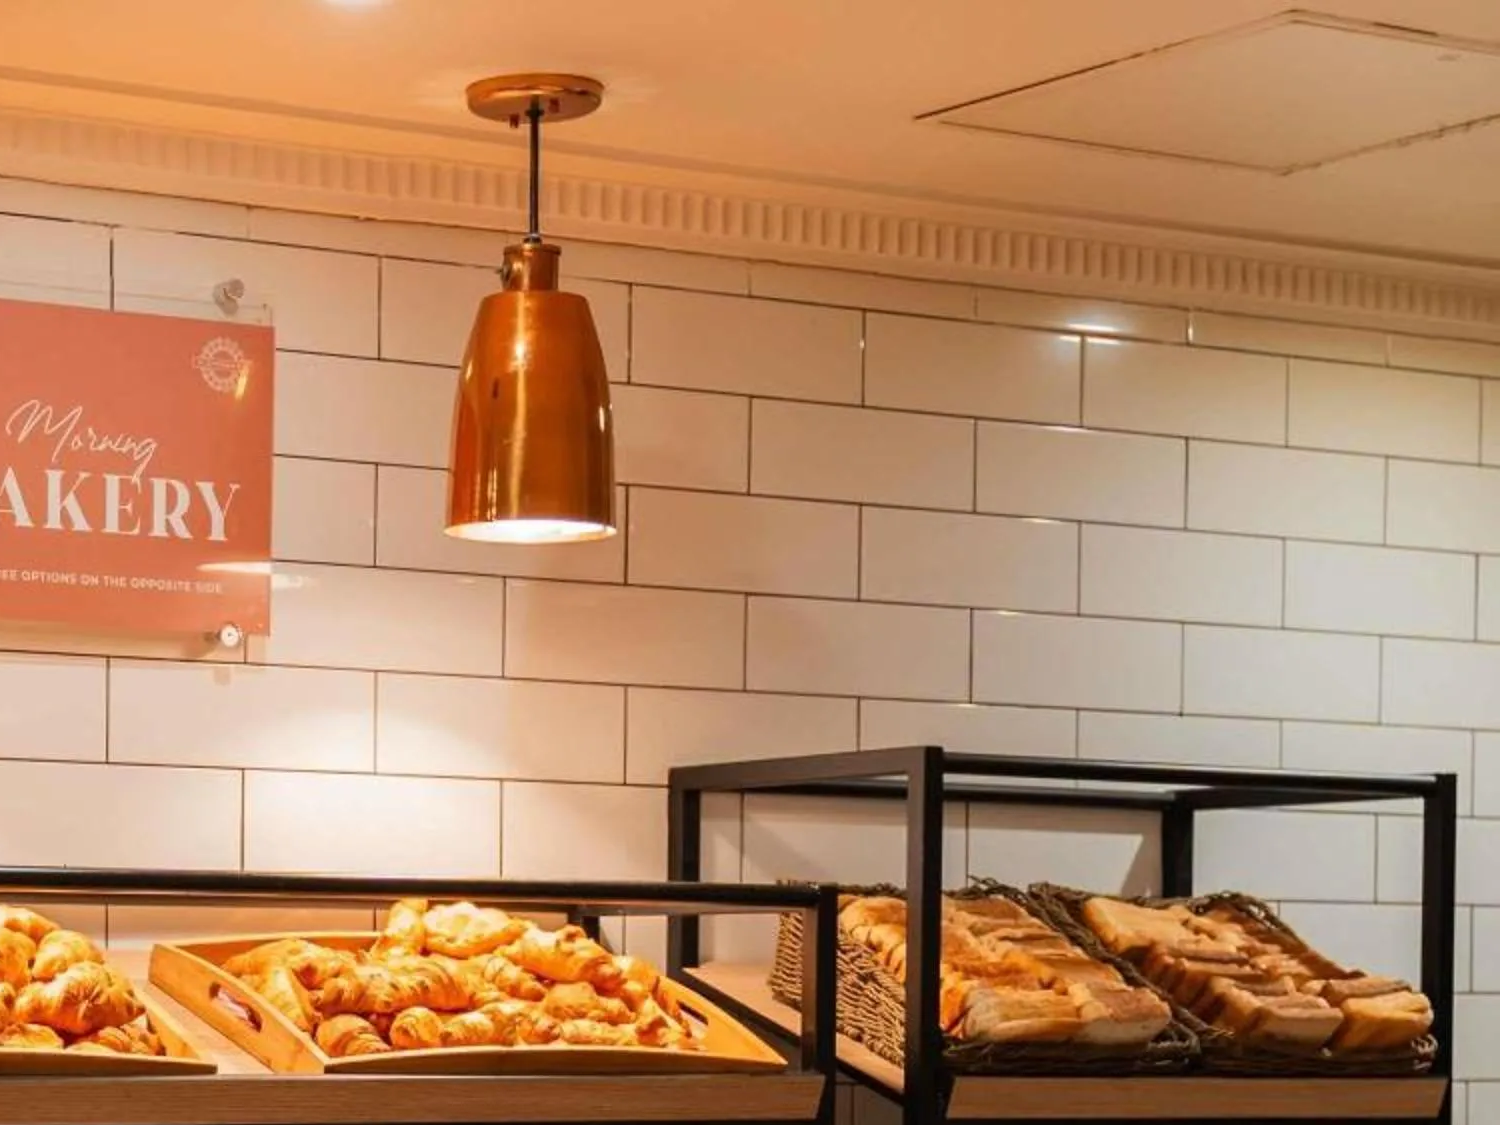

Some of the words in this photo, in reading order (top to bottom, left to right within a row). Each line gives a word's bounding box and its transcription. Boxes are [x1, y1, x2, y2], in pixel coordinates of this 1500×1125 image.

[5, 400, 157, 494] Morning
[21, 570, 77, 585] OPTIONS
[81, 574, 99, 586] ON
[104, 575, 127, 588] THE
[131, 577, 191, 593] OPPOSITE
[196, 581, 223, 594] SIDE
